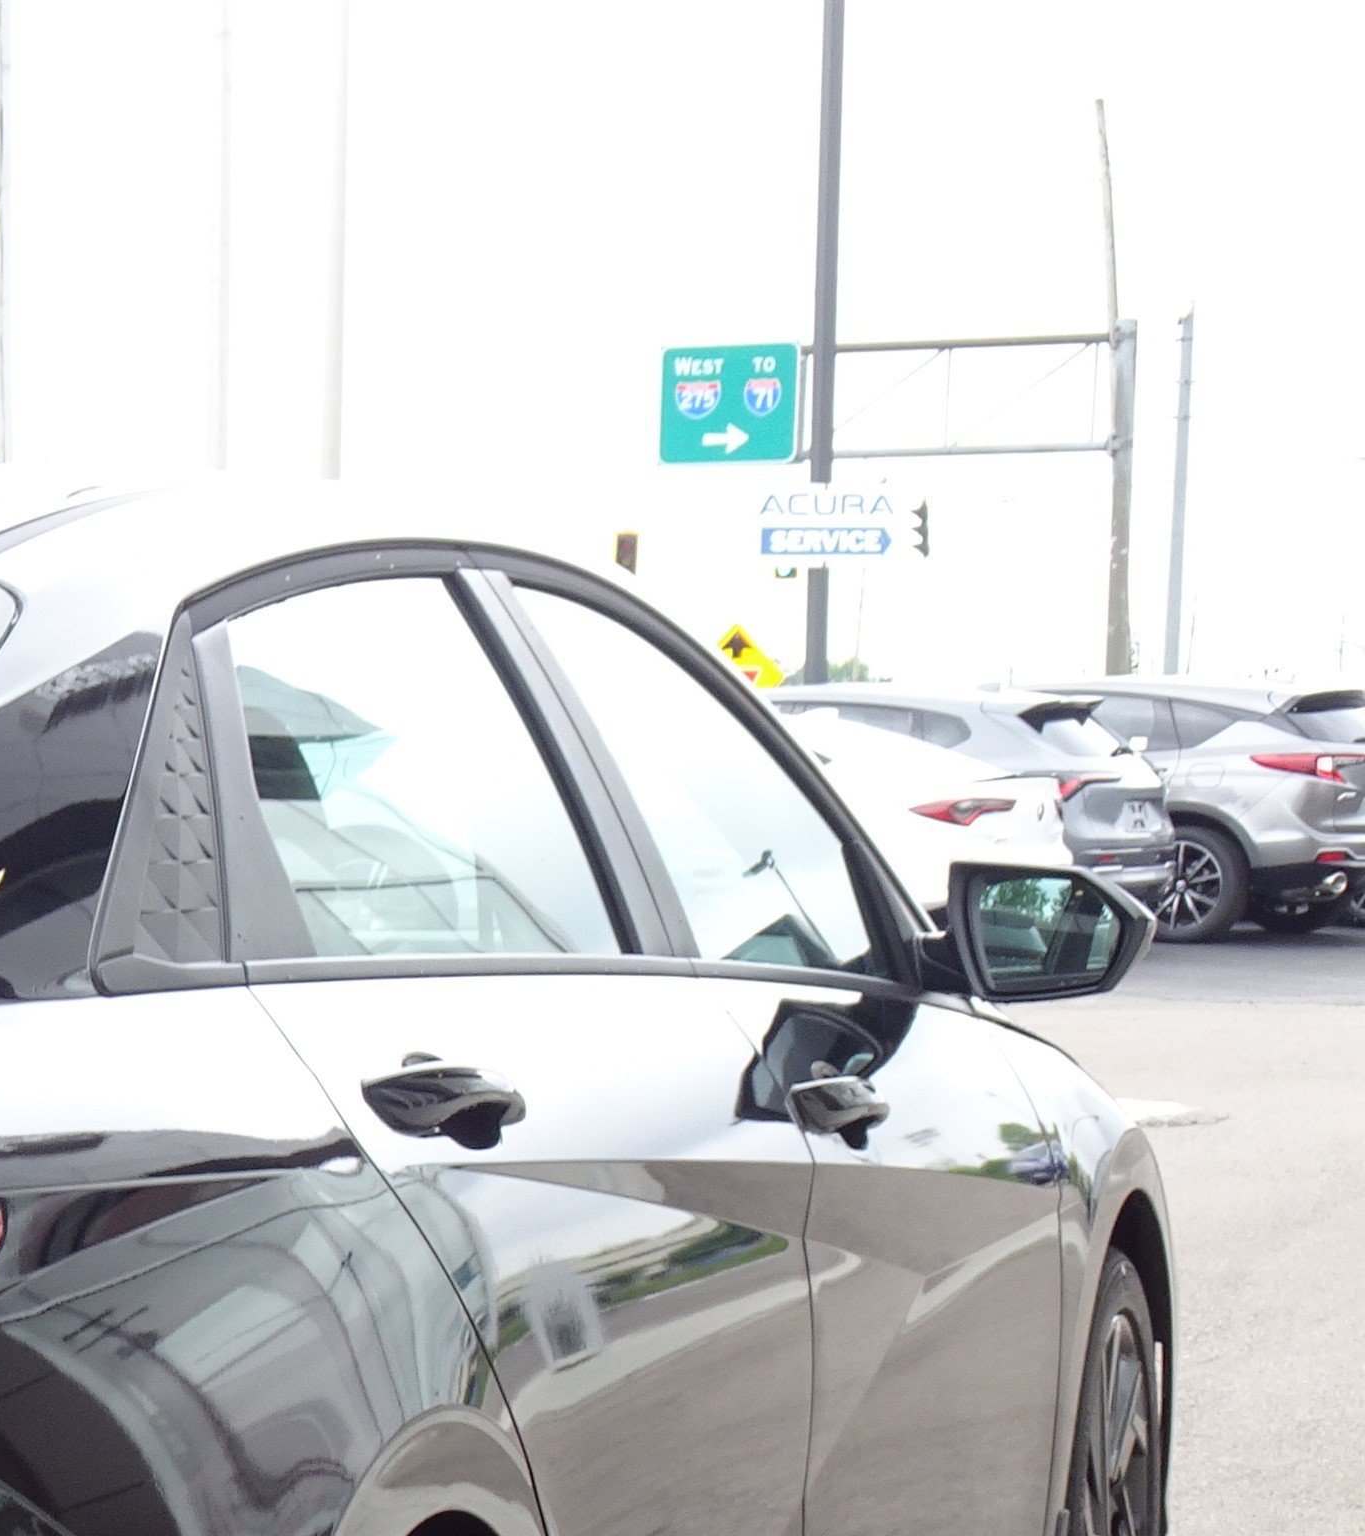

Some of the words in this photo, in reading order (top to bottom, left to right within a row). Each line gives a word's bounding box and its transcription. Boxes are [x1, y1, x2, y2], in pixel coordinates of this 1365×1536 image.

[674, 356, 724, 376] WEST
[752, 356, 777, 373] TO
[679, 388, 716, 411] 275
[752, 388, 773, 409] 71
[760, 493, 893, 515] ACURA
[769, 529, 883, 553] SERVICE
